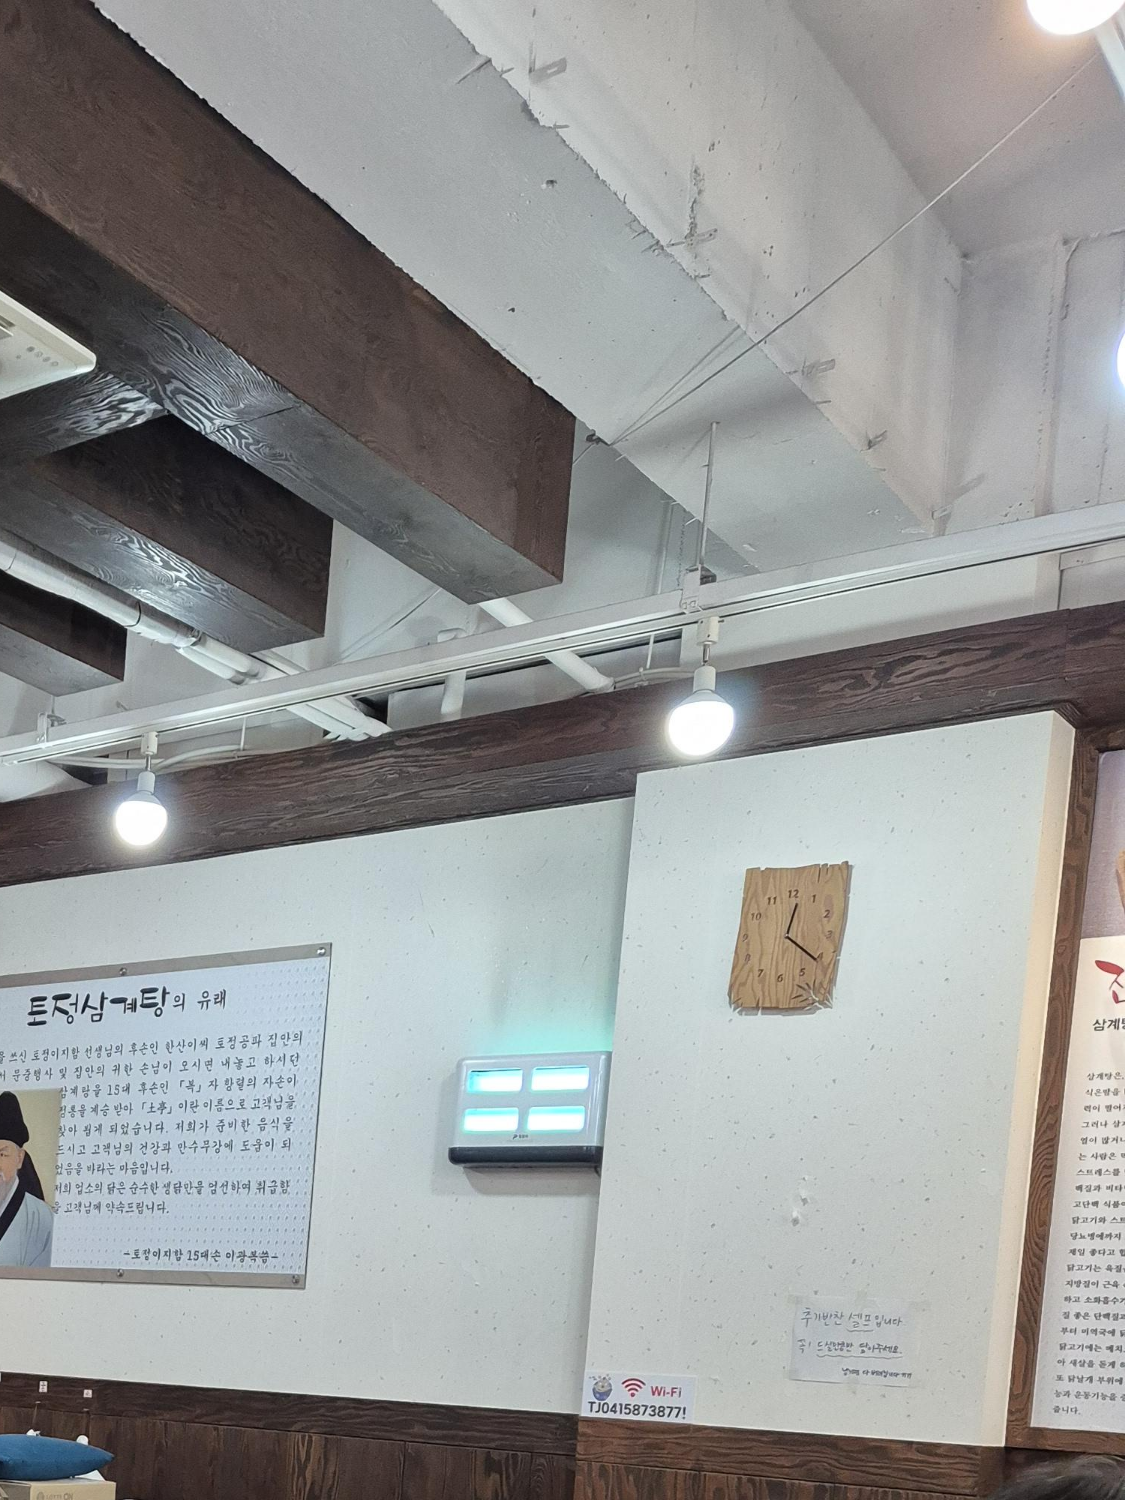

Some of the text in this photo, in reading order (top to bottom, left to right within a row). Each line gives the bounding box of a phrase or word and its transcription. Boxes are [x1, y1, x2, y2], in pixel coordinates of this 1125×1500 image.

[788, 889, 800, 899] 12
[767, 896, 778, 905] 11
[751, 912, 762, 921] 10
[823, 909, 830, 919] 2
[825, 930, 833, 939] 3
[757, 969, 764, 978] 7
[799, 967, 806, 977] 5
[777, 973, 784, 983] 6
[27, 985, 226, 1026] 토정삼계탕의 유래
[1092, 1017, 1125, 1032] 삼계
[9, 1049, 27, 1064] 쓰신
[31, 1046, 80, 1062] 토정이지함
[84, 1043, 124, 1059] 선생님의
[128, 1041, 159, 1056] 후손인
[165, 1037, 209, 1054] 한산이씨
[215, 1033, 262, 1050] 토정공파
[267, 1030, 303, 1048] 집안의
[12, 1067, 53, 1083] 문중행사
[59, 1066, 67, 1080] 및
[74, 1064, 105, 1079] 집안의
[111, 1063, 133, 1077] 귀한
[139, 1060, 172, 1076] 손님이
[179, 1058, 213, 1073] 오시면
[221, 1056, 256, 1071] 내놓고
[264, 1052, 299, 1068] 하시던
[107, 1082, 131, 1096] 15대
[138, 1080, 169, 1096] 후손인
[224, 1075, 257, 1092] 항렬의
[263, 1073, 297, 1089] 자손이
[114, 1102, 134, 1117] 받아
[203, 1098, 247, 1112] 이름으로
[251, 1094, 296, 1110] 고객님을
[59, 1123, 78, 1138] 찾아
[109, 1120, 169, 1136] 되었습니다.
[175, 1119, 209, 1132] 저희가
[216, 1118, 250, 1133] 준비한
[257, 1116, 293, 1132] 음식을
[1081, 1120, 1108, 1129] 그러나
[56, 1137, 291, 1156] 드시고 고객님의 건강과 만수무강에 도움이 되
[1078, 1152, 1087, 1161] 는
[1090, 1152, 1117, 1161] 사람은
[87, 1162, 116, 1176] 바라는
[119, 1161, 173, 1175] 마음입니다.
[1076, 1168, 1120, 1177] 스트레스를
[54, 1179, 290, 1196] 저희 업소의 닭은 순수한 생닭만을 엄선하여 취급함
[1106, 1184, 1125, 1193] 비타
[52, 1201, 61, 1214] 을
[106, 1201, 170, 1214] 약속드립니다.
[1073, 1200, 1100, 1209] 고단백
[1071, 1215, 1107, 1225] 닭고기와
[187, 1249, 221, 1263] 15대손
[1066, 1263, 1125, 1273] 닭고기는 육질
[1065, 1279, 1099, 1289] 지방질이
[1064, 1295, 1081, 1304] 하고
[1060, 1327, 1077, 1335] 부터
[1081, 1327, 1116, 1337] 미역국에
[1059, 1342, 1125, 1353] 닭고기에는 메치
[1057, 1358, 1066, 1366] 아
[1068, 1374, 1094, 1384] 닭날개
[1097, 1376, 1124, 1386] 부위에
[650, 1385, 682, 1398] Wi-Fi
[1074, 1390, 1117, 1401] 운동기능을
[588, 1401, 687, 1420] TJ0415873877!
